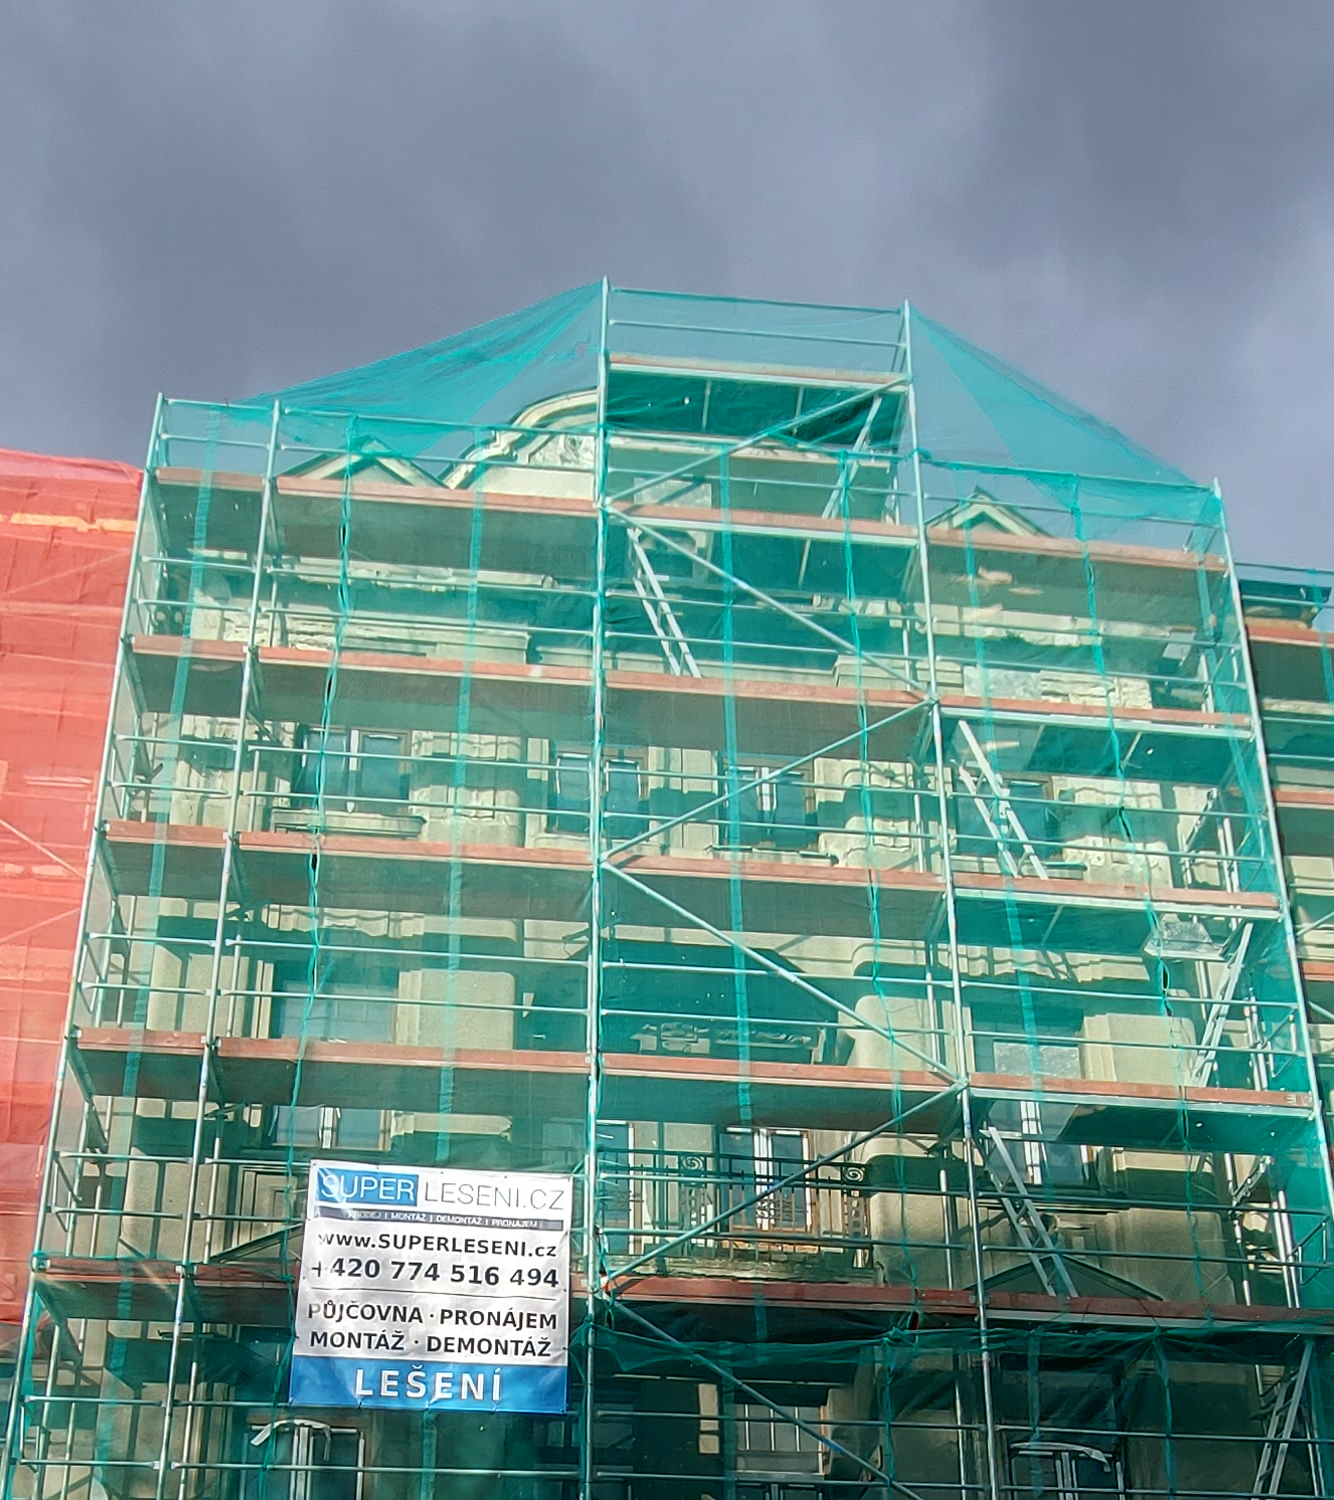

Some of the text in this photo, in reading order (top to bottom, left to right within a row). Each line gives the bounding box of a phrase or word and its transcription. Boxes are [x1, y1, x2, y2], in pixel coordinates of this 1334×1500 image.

[321, 1175, 564, 1210] SUPER LESENI.CZ
[318, 1233, 556, 1257] www.SUPERLESENI.cz
[390, 1261, 441, 1282] 774
[450, 1264, 500, 1286] 516
[509, 1268, 559, 1288] 494
[308, 1299, 557, 1331] PŮJČOVNA PRONÁJEM
[310, 1329, 552, 1357] MONTÁŽ DEMONTÁŽ
[355, 1364, 502, 1401] LEŠENÍ
